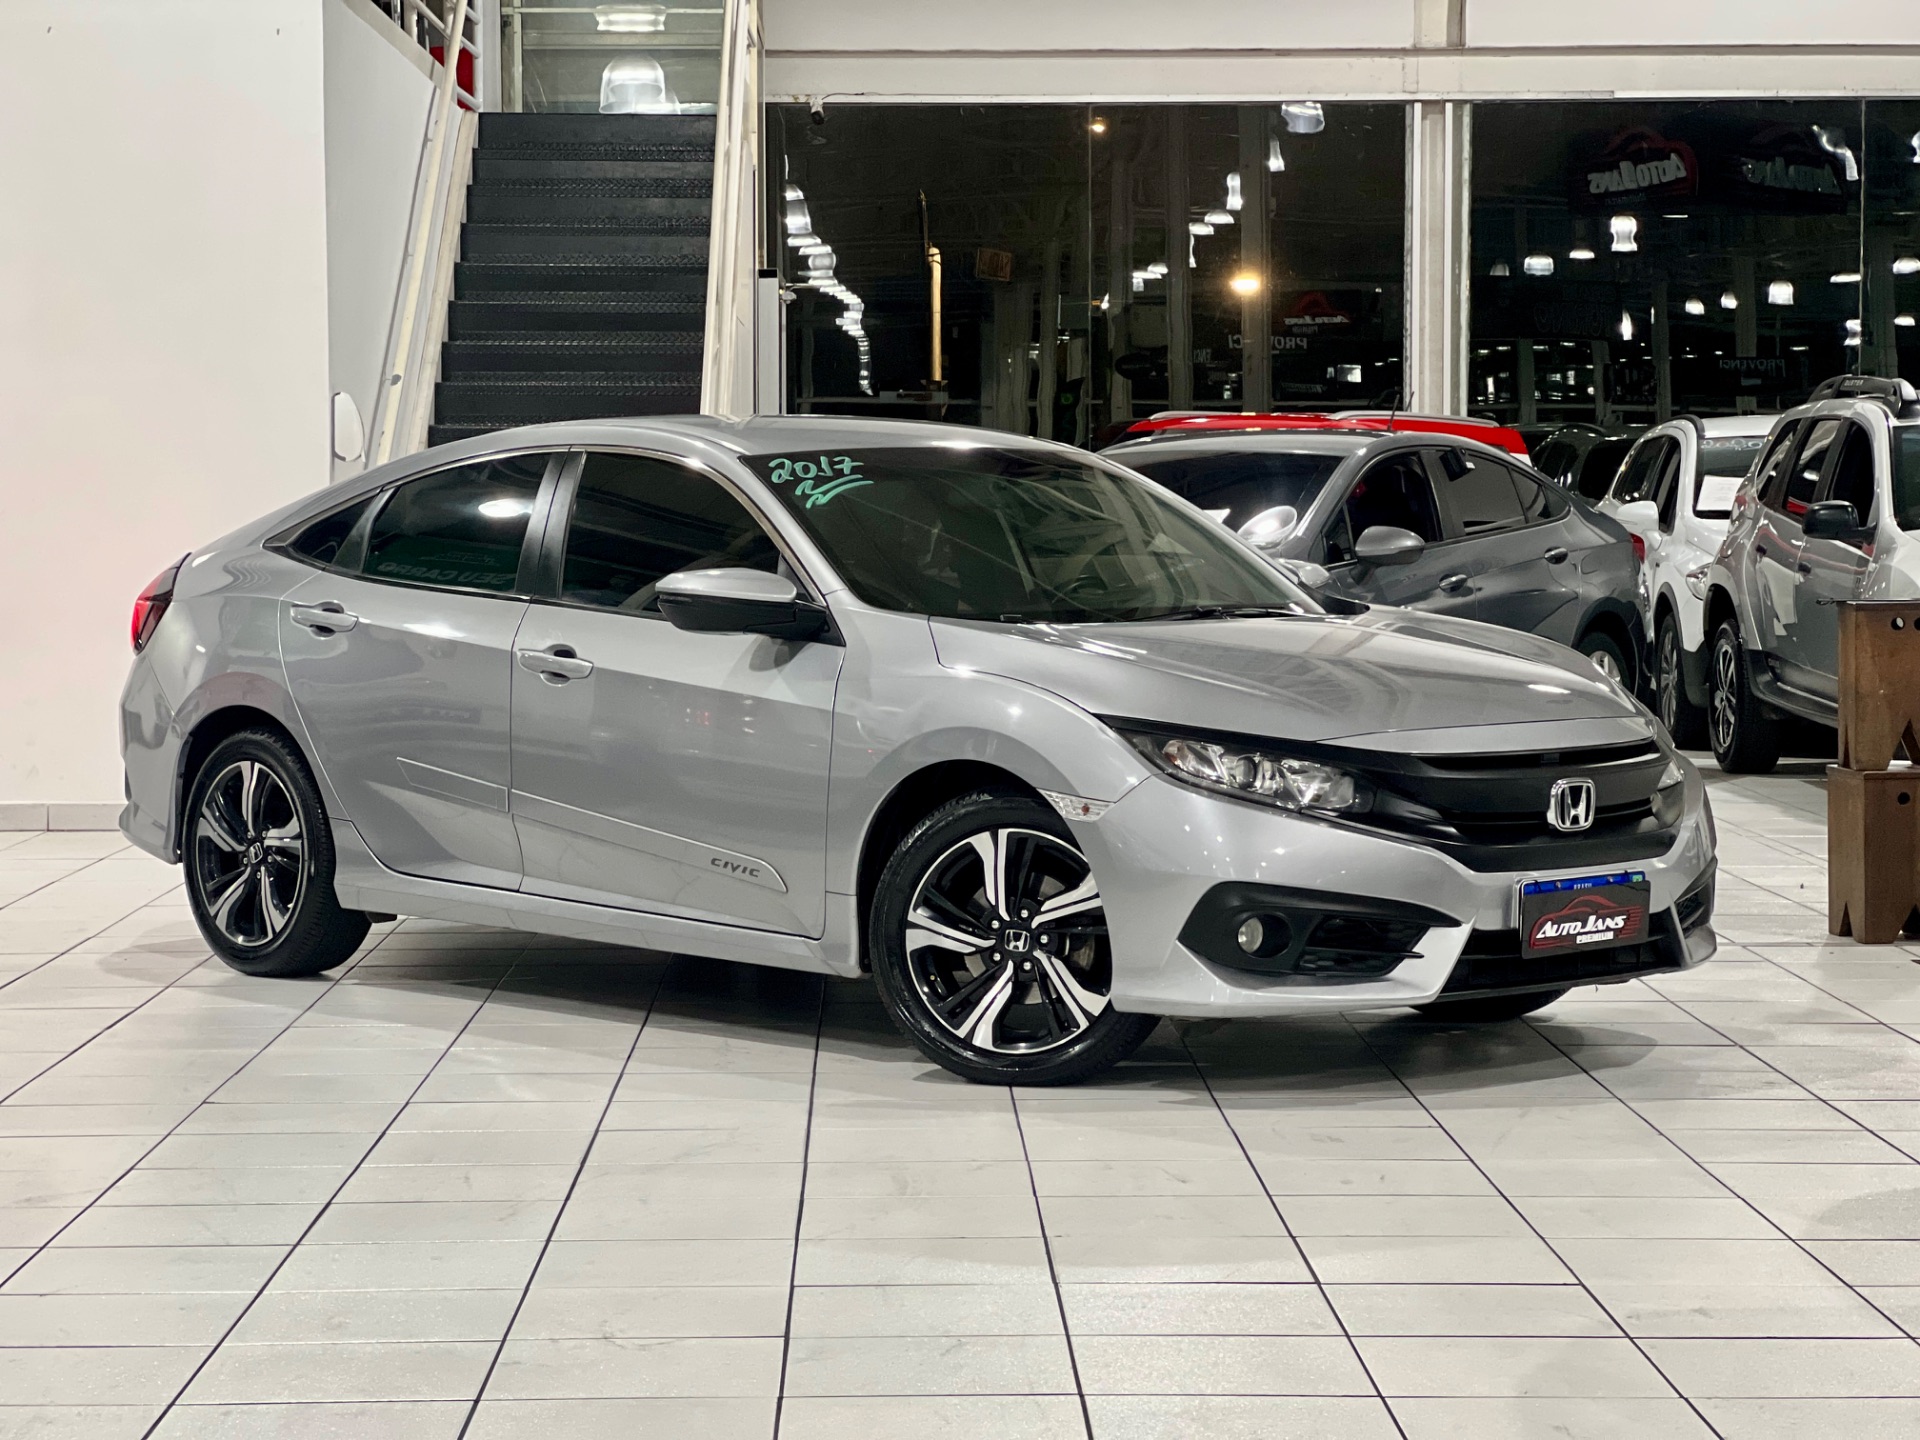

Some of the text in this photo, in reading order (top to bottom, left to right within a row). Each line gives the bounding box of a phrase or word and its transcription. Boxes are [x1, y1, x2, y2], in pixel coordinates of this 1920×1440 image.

[768, 455, 865, 484] 2017
[710, 857, 761, 878] CIVIC
[1576, 931, 1614, 944] PREMIUM
